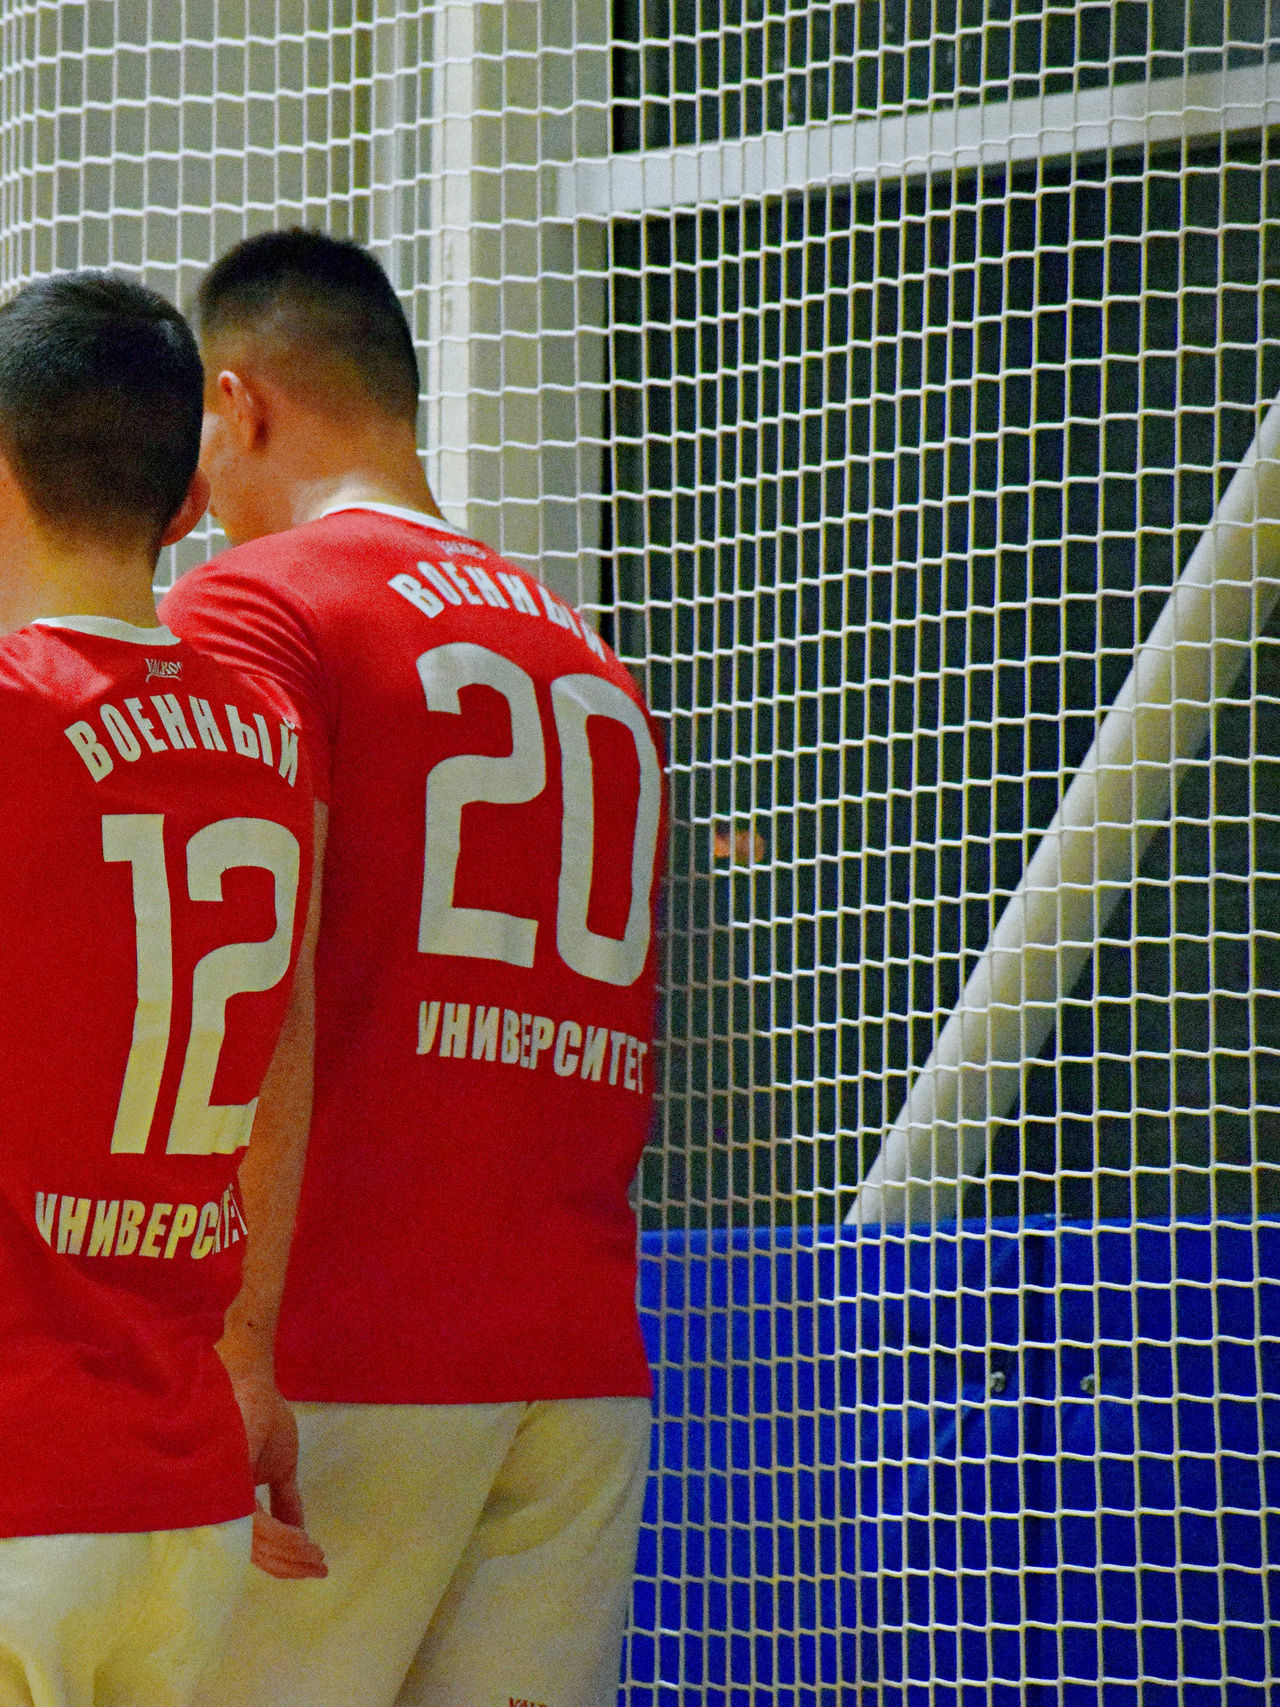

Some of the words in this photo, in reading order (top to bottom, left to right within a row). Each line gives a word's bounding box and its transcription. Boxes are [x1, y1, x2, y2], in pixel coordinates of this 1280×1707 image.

[63, 693, 299, 788] ВОЕННЫЙ
[415, 641, 662, 987] 20
[101, 813, 302, 1155] 12
[415, 1000, 649, 1095] УНИВЕРСИТЕТ
